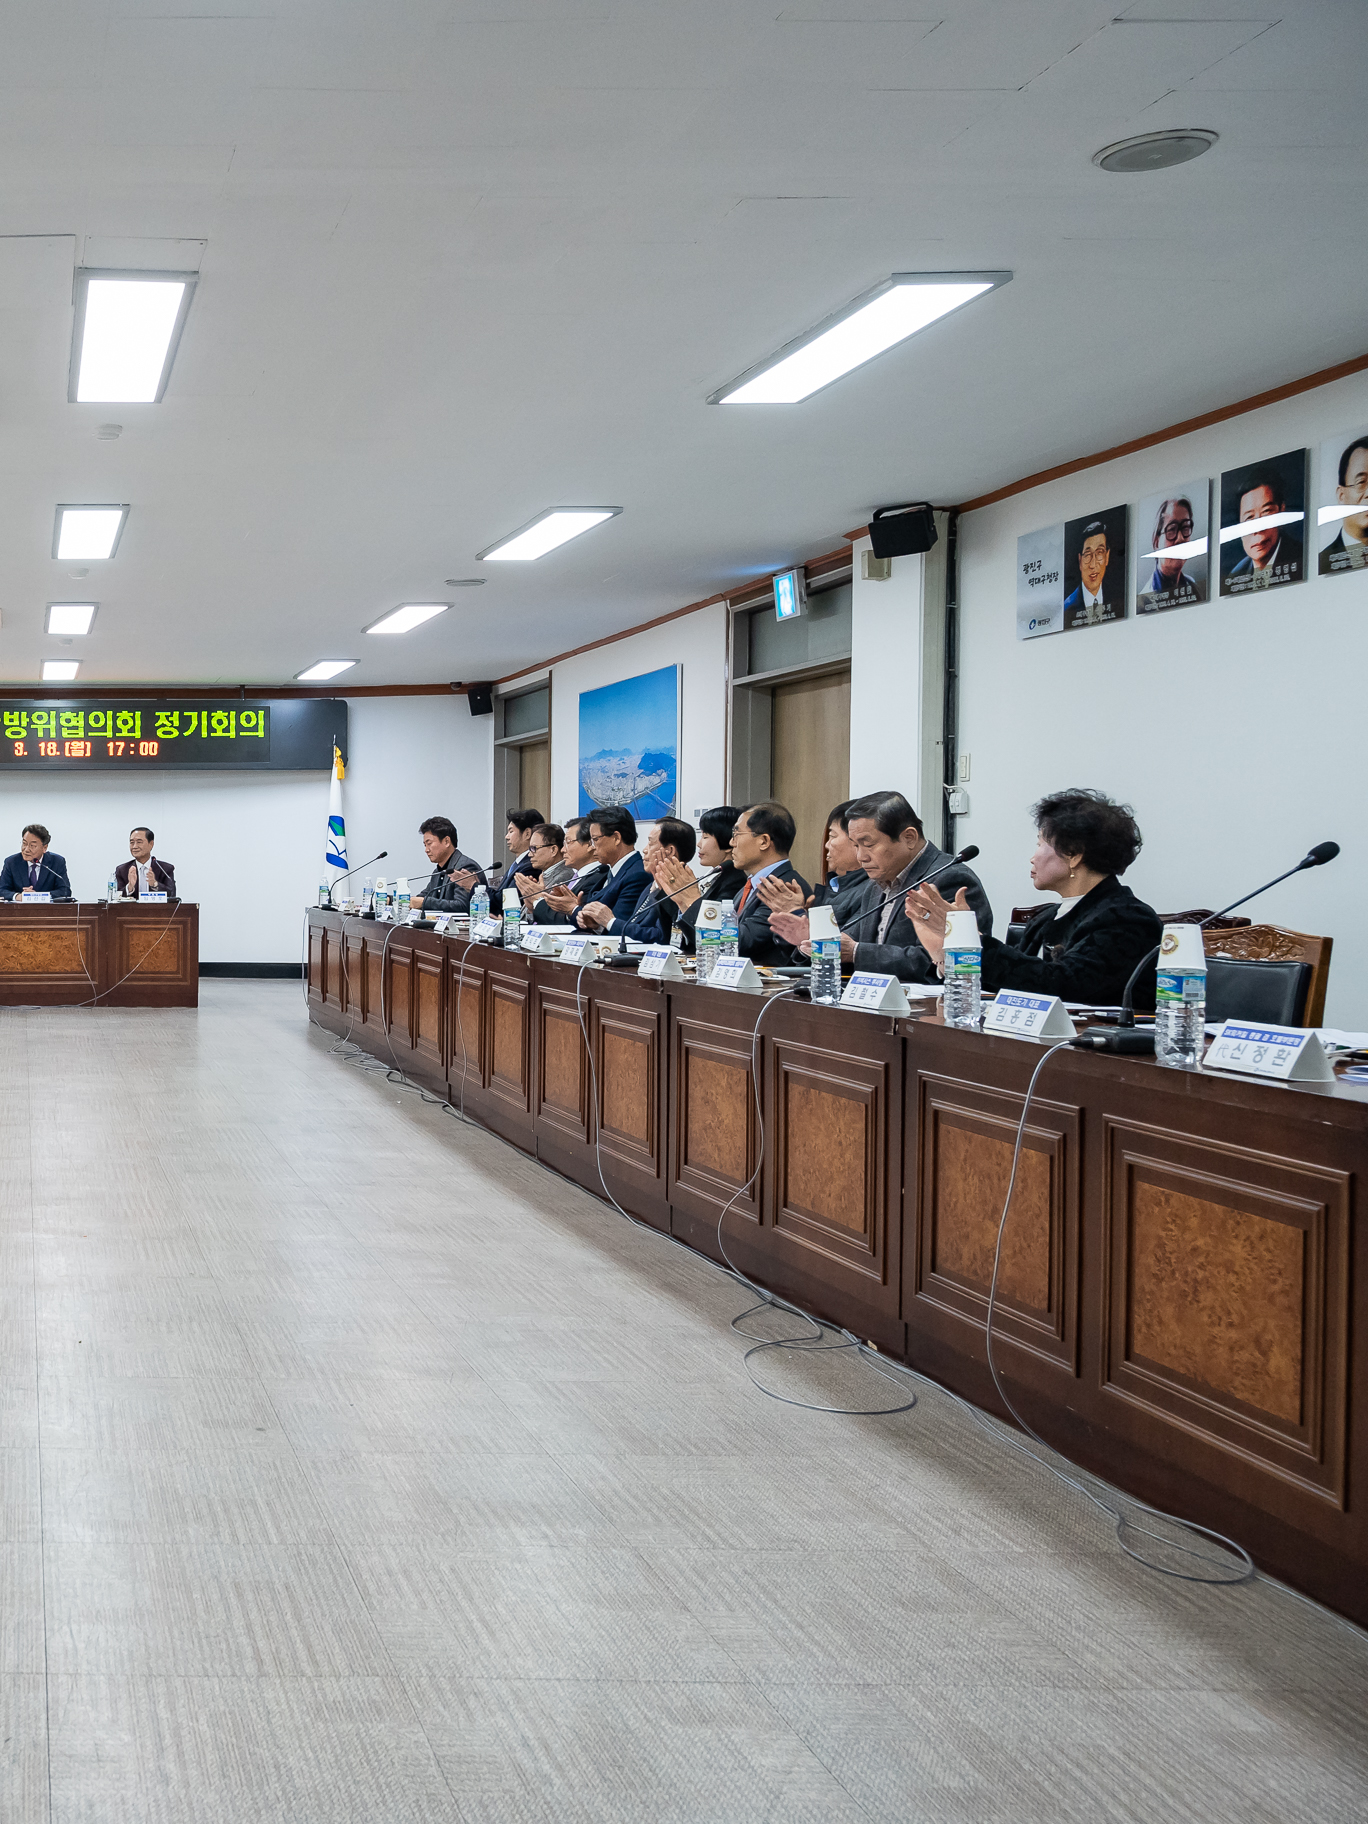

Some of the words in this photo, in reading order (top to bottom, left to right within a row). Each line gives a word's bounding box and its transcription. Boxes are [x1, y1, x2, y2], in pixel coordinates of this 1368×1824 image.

[1023, 560, 1042, 574] 광진구
[1028, 571, 1059, 587] 역대구청장
[154, 710, 265, 739] 정기회의
[14, 742, 28, 757] 3.
[1229, 1042, 1292, 1067] 신정환
